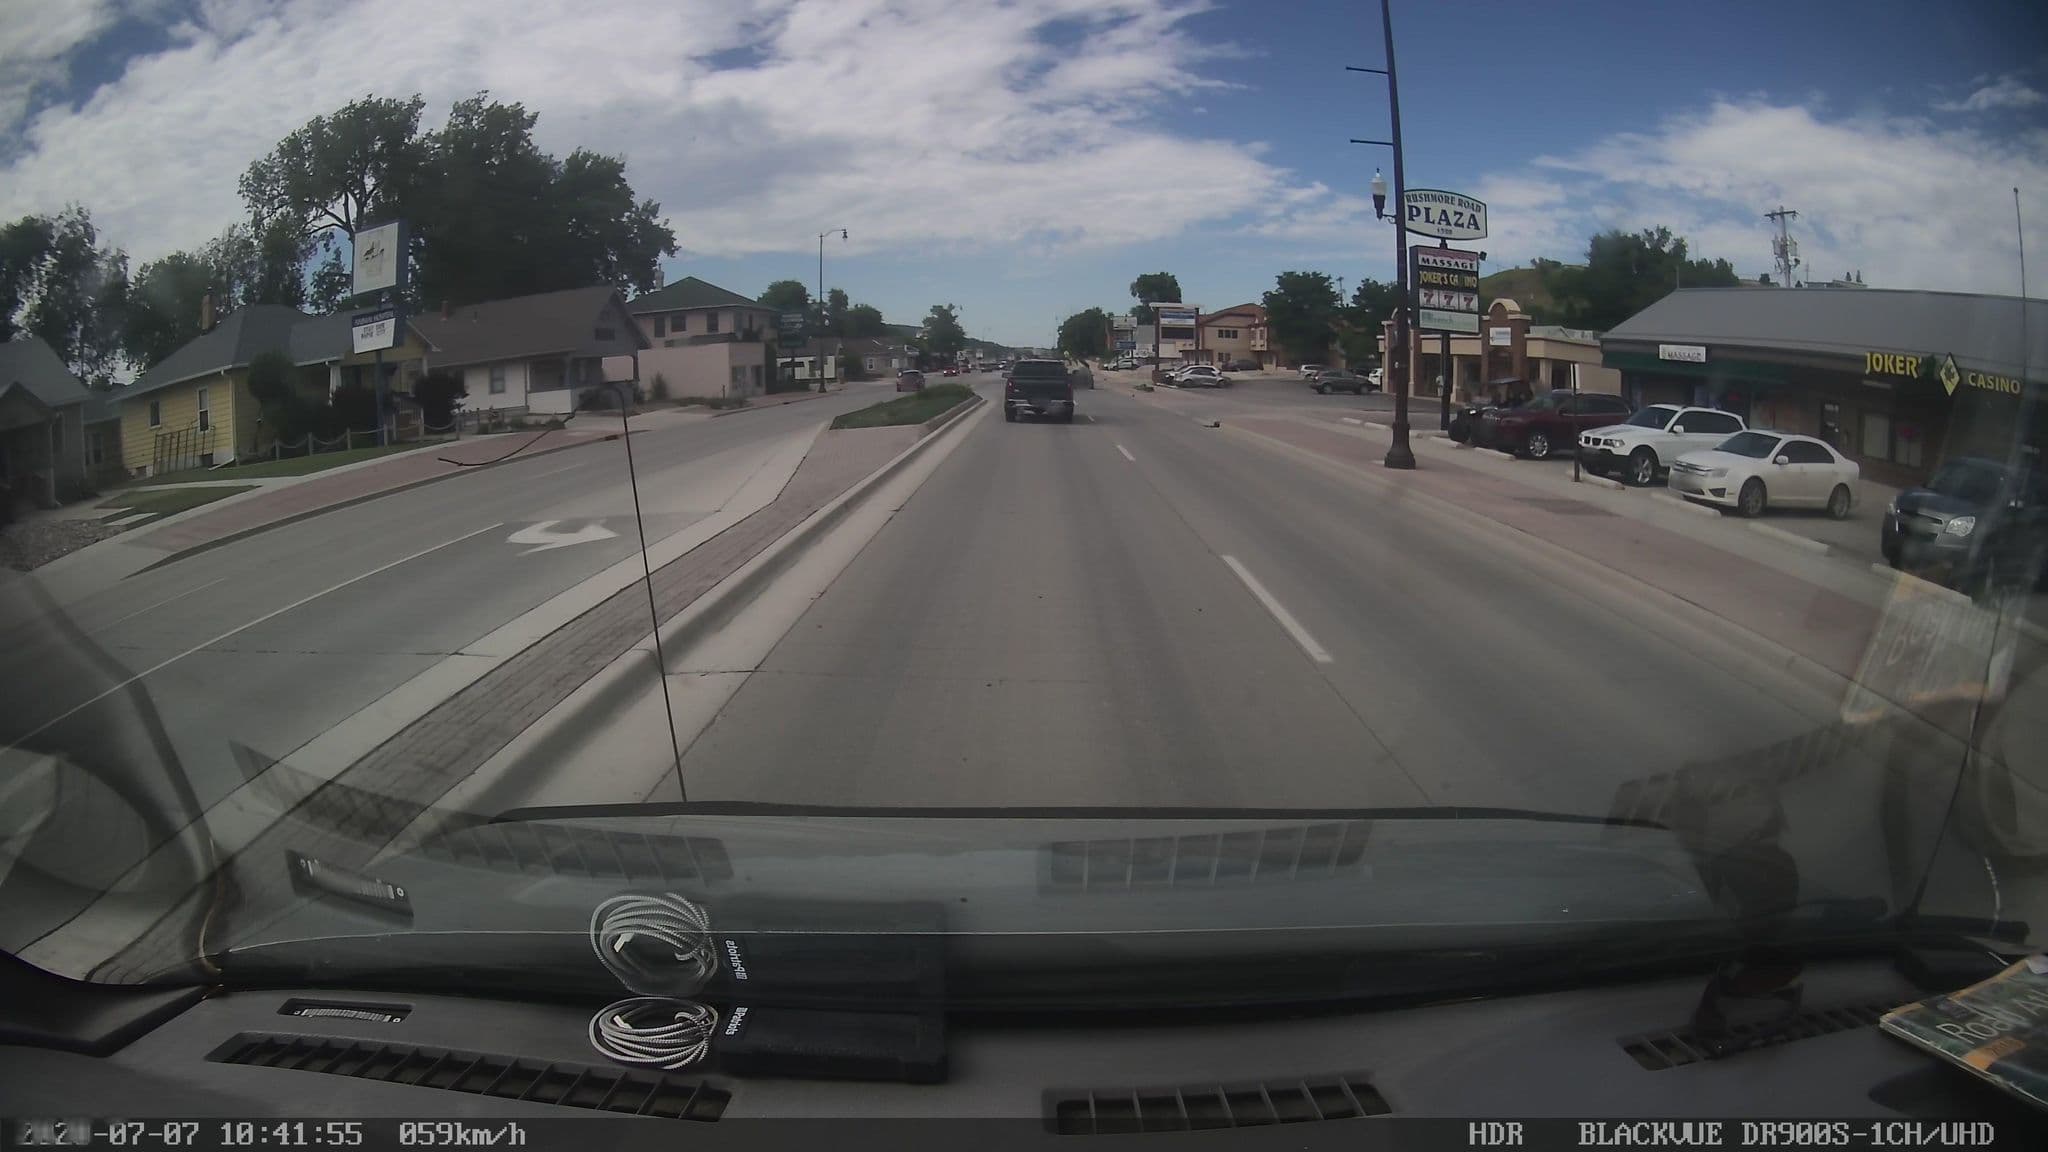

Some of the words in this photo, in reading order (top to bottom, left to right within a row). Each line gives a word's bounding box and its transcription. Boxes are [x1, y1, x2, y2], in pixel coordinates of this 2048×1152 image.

[1406, 193, 1455, 205] RUSHMORE
[1458, 197, 1482, 213] ROAD
[1407, 204, 1481, 231] PLAZA
[1421, 256, 1475, 270] MASSAGE
[1419, 270, 1448, 286] JOKER'S
[1667, 350, 1702, 361] MASSAGE
[1968, 372, 2022, 395] CASINO
